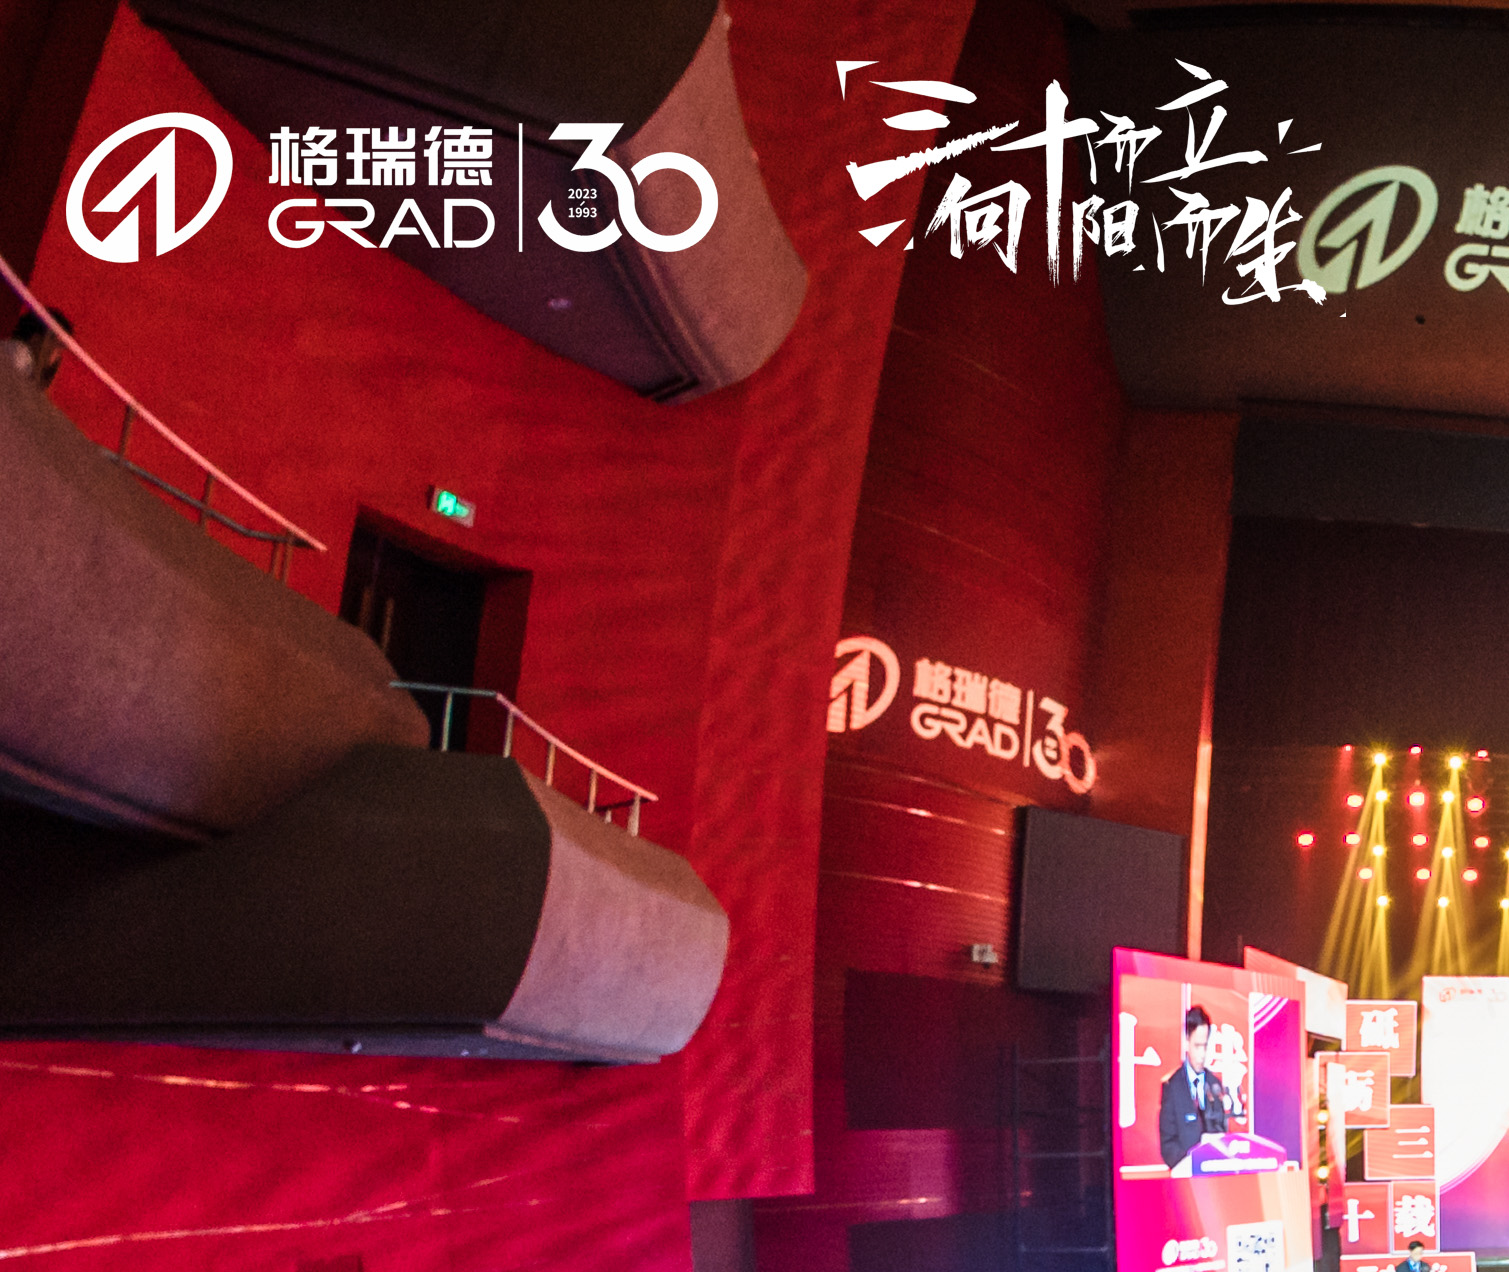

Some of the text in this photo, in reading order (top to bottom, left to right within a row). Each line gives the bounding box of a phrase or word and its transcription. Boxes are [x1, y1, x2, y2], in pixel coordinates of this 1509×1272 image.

[913, 657, 1022, 725] 格瑞德
[910, 702, 1020, 761] GRAD
